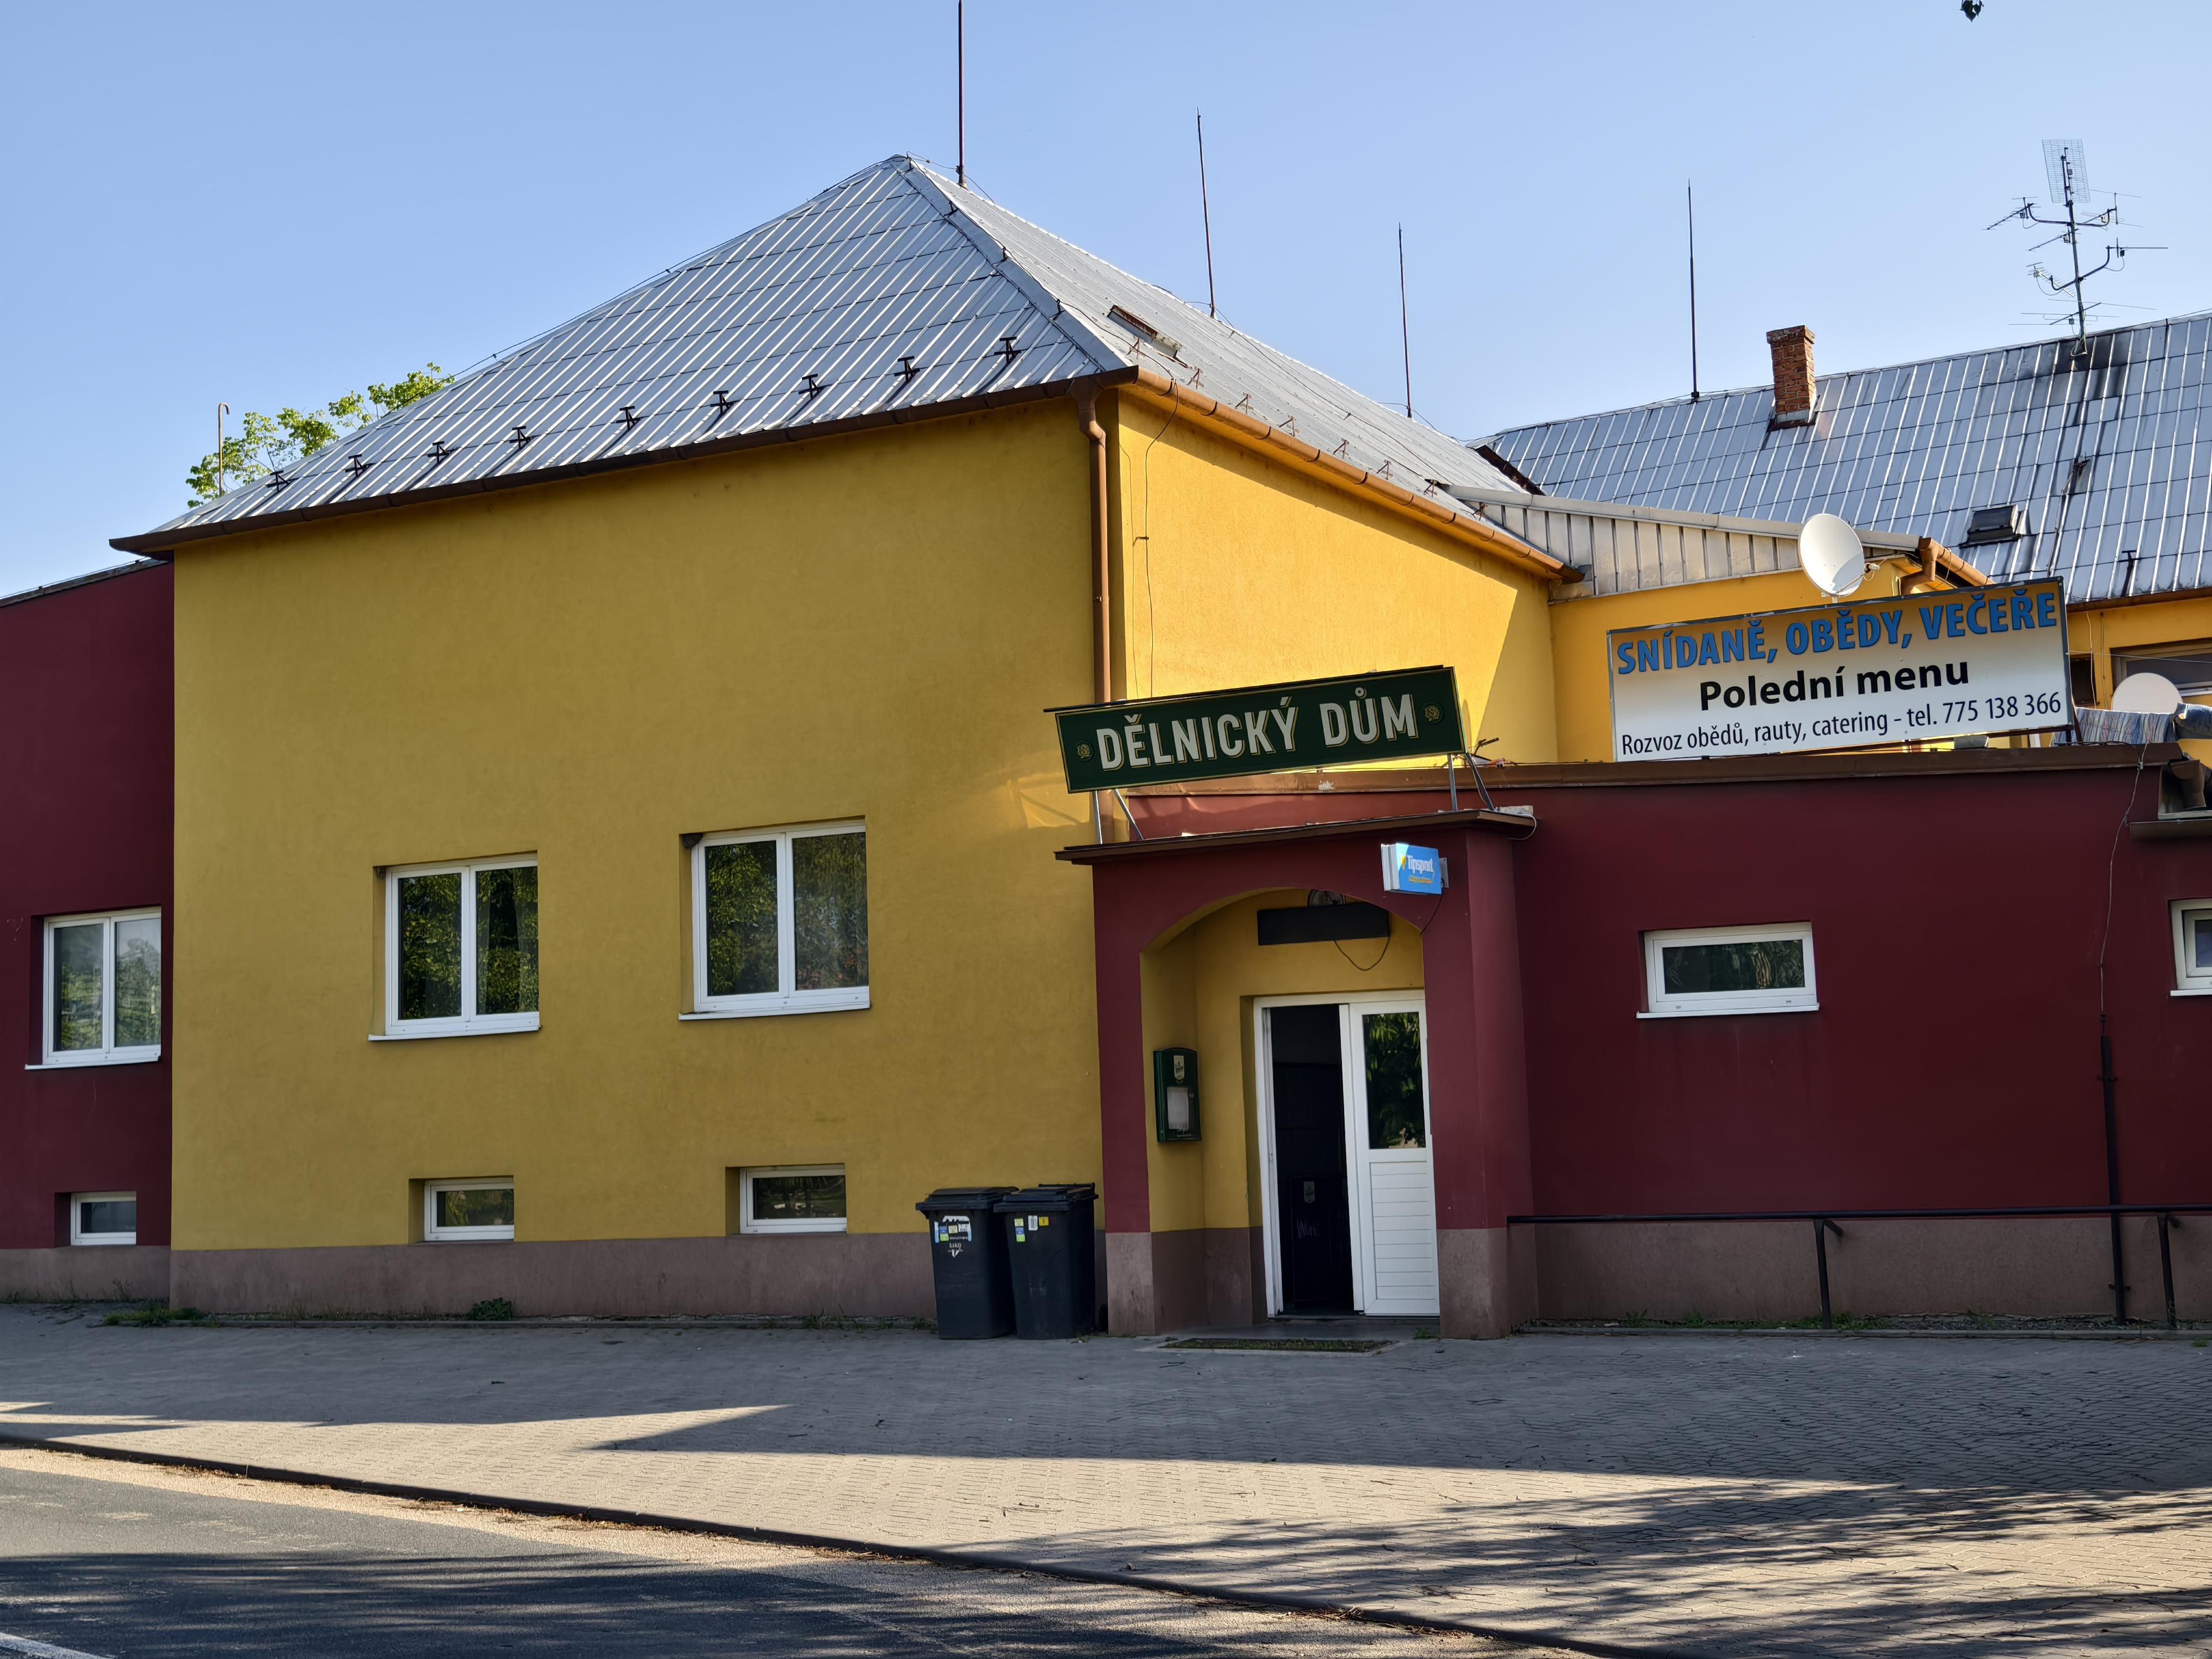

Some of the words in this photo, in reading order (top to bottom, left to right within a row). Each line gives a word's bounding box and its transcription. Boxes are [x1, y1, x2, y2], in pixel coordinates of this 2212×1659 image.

[1617, 619, 1777, 674] SNÍDANĚ,
[1786, 609, 1913, 655] OBĚDY,
[1918, 588, 2057, 640] VEČEŘE
[1622, 734, 1683, 755] Rozvoz
[1687, 722, 1749, 749] obědů,
[1754, 719, 1807, 745] rauty,
[1812, 711, 1888, 737] catering
[1907, 705, 1937, 727] tel.
[1943, 699, 1978, 724] 775
[1985, 696, 2018, 720] 138
[2024, 691, 2061, 716] 366
[1700, 666, 1845, 711] Polední
[1857, 661, 1969, 695] menu
[1097, 696, 1298, 771] DĚLNICKÝ
[1319, 687, 1418, 748] DŮM
